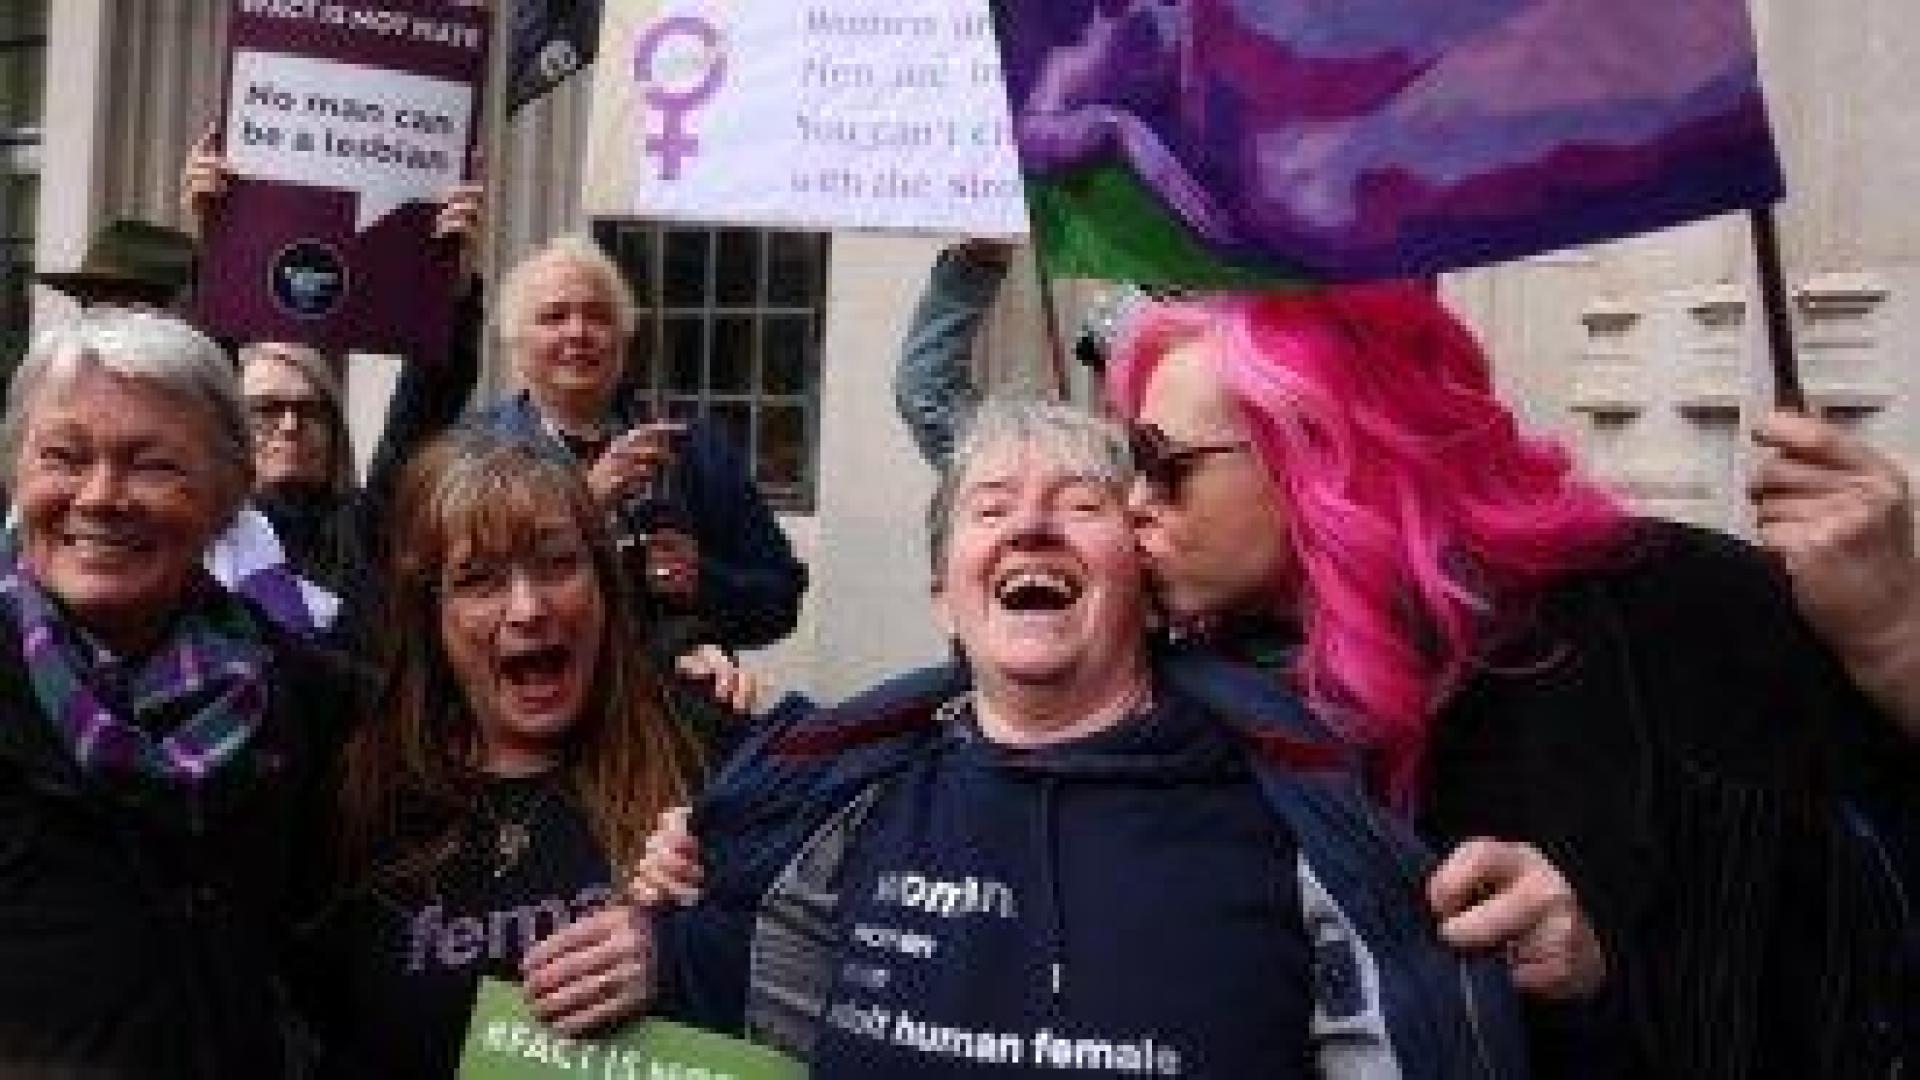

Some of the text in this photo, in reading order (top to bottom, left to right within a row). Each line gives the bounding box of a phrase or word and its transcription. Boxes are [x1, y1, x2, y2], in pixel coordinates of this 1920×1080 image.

[246, 83, 454, 134] No man can
[243, 121, 451, 170] be a lesbian
[892, 1010, 1023, 1065] human
[1031, 1026, 1183, 1076] female
